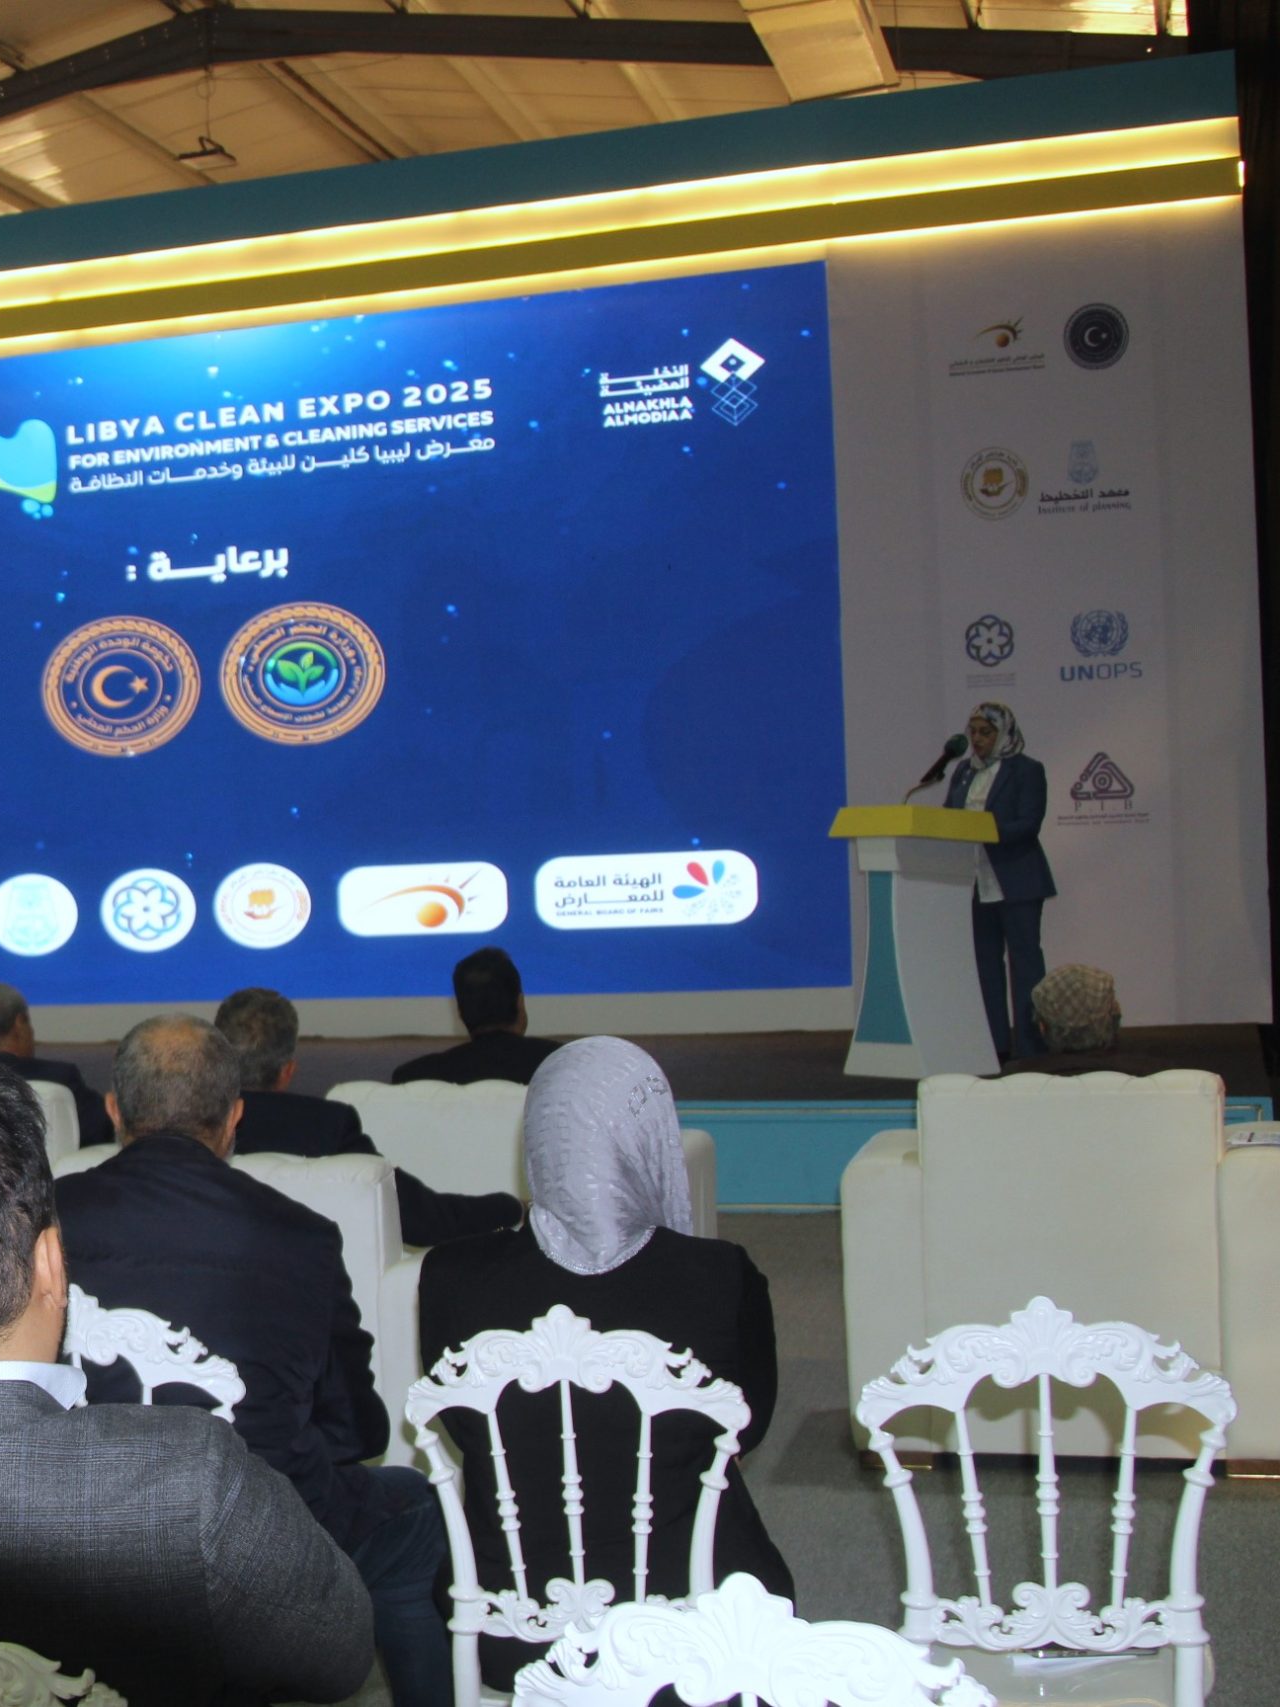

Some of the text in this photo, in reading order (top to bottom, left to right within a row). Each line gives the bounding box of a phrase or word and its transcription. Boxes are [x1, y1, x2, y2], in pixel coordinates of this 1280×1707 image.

[66, 378, 493, 445] LIBYA CLEAN EXPO 2025
[603, 396, 693, 415] ALNAKHLA
[603, 409, 693, 427] ALMODIAA
[69, 410, 494, 470] FOR ENVIRONMENT & CLEANING SERVICES
[69, 437, 495, 494] معرض ليبيا كلين للبيئة وخدمات النظافة
[147, 546, 289, 584] برعاية
[1059, 661, 1143, 682] UNOPS
[554, 872, 662, 889] الهيئة العامة
